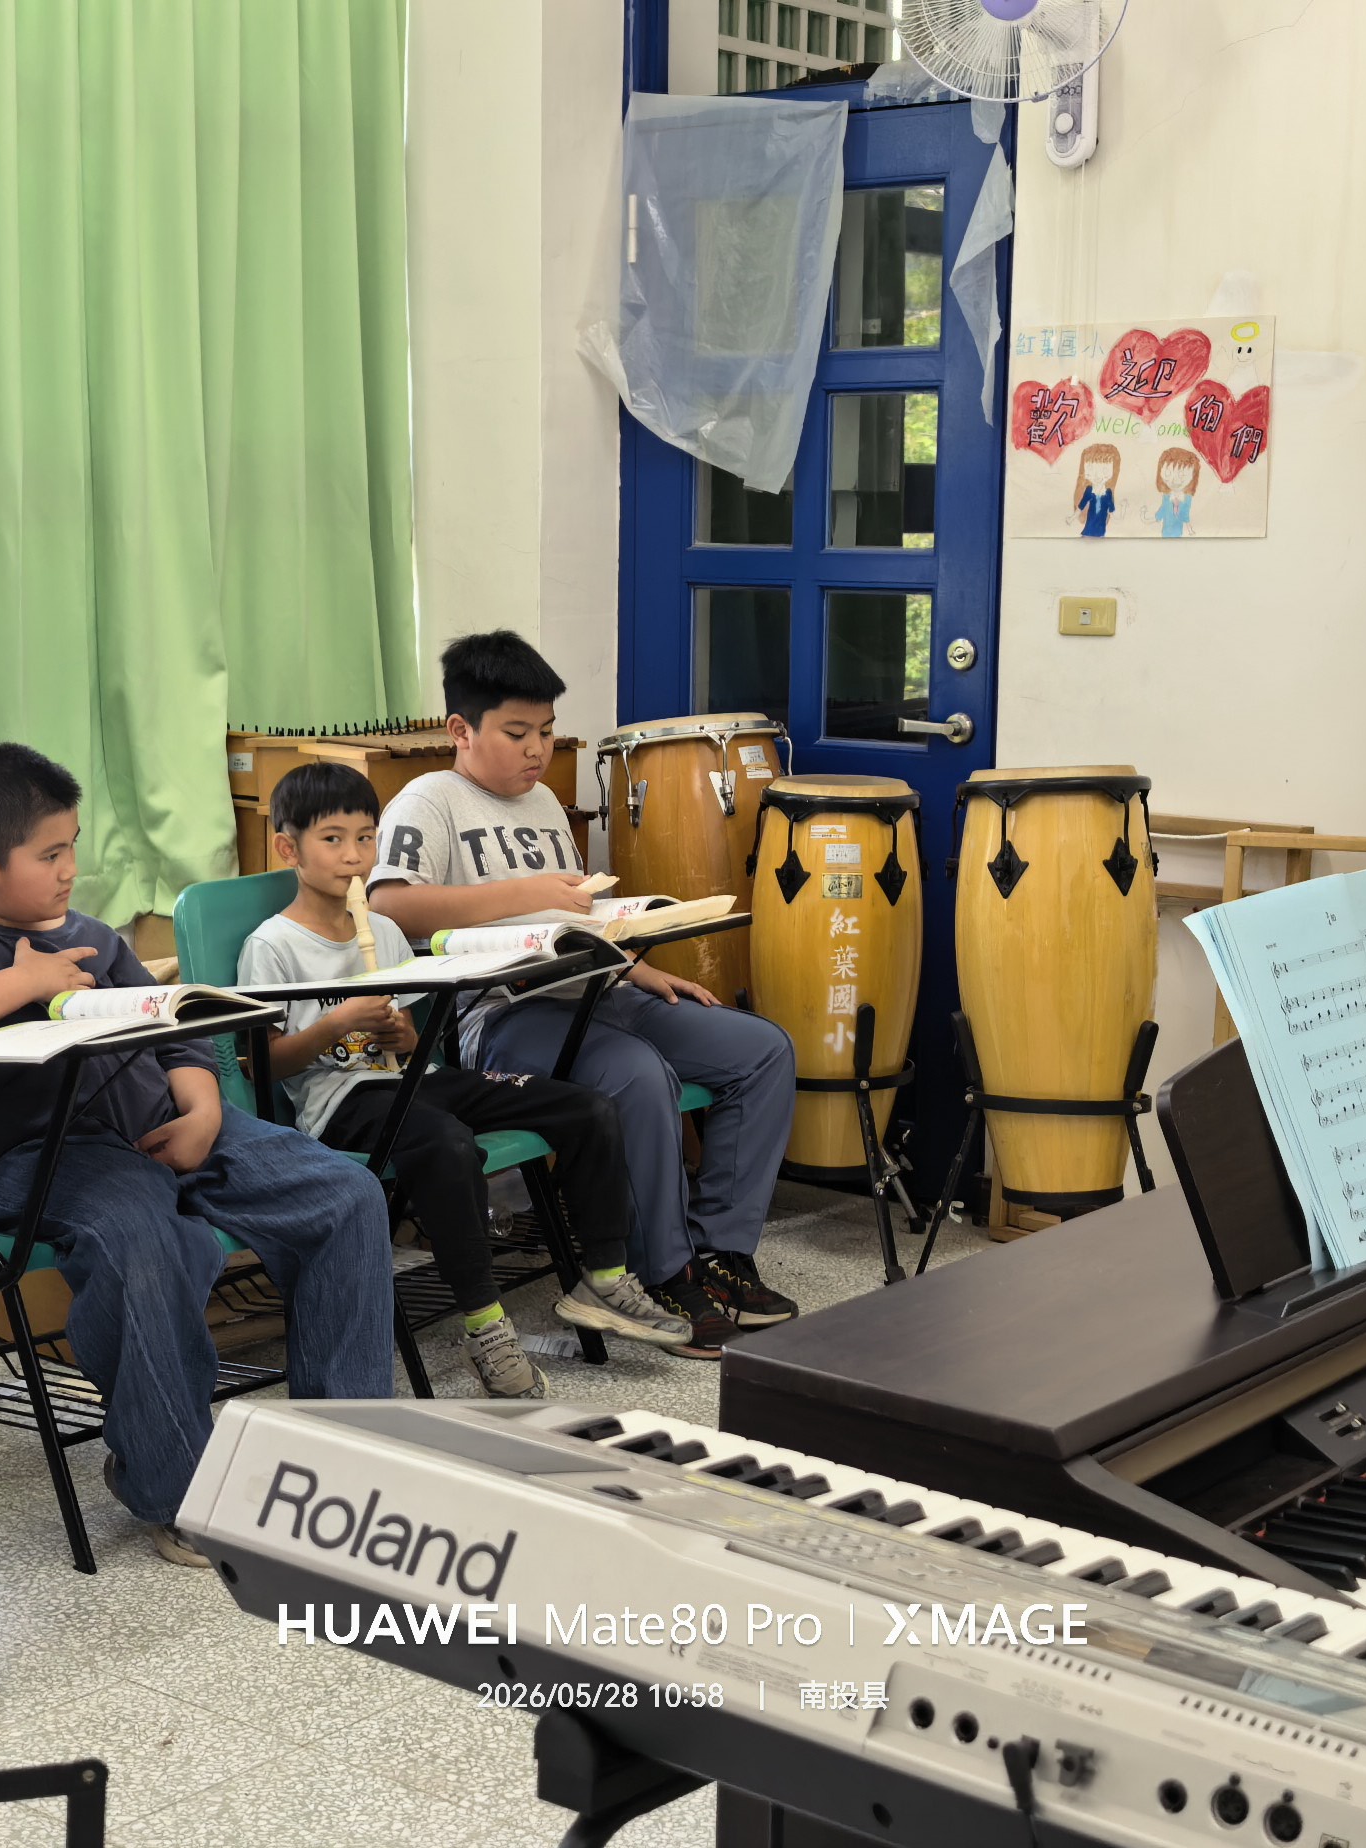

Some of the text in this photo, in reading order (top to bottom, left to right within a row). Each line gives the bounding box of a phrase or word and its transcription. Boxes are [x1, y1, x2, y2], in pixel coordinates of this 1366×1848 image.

[1016, 328, 1105, 358] 紅葉國小
[1105, 348, 1177, 399] 迎
[823, 907, 861, 1054] 紅葉國小
[256, 1460, 518, 1602] Roland
